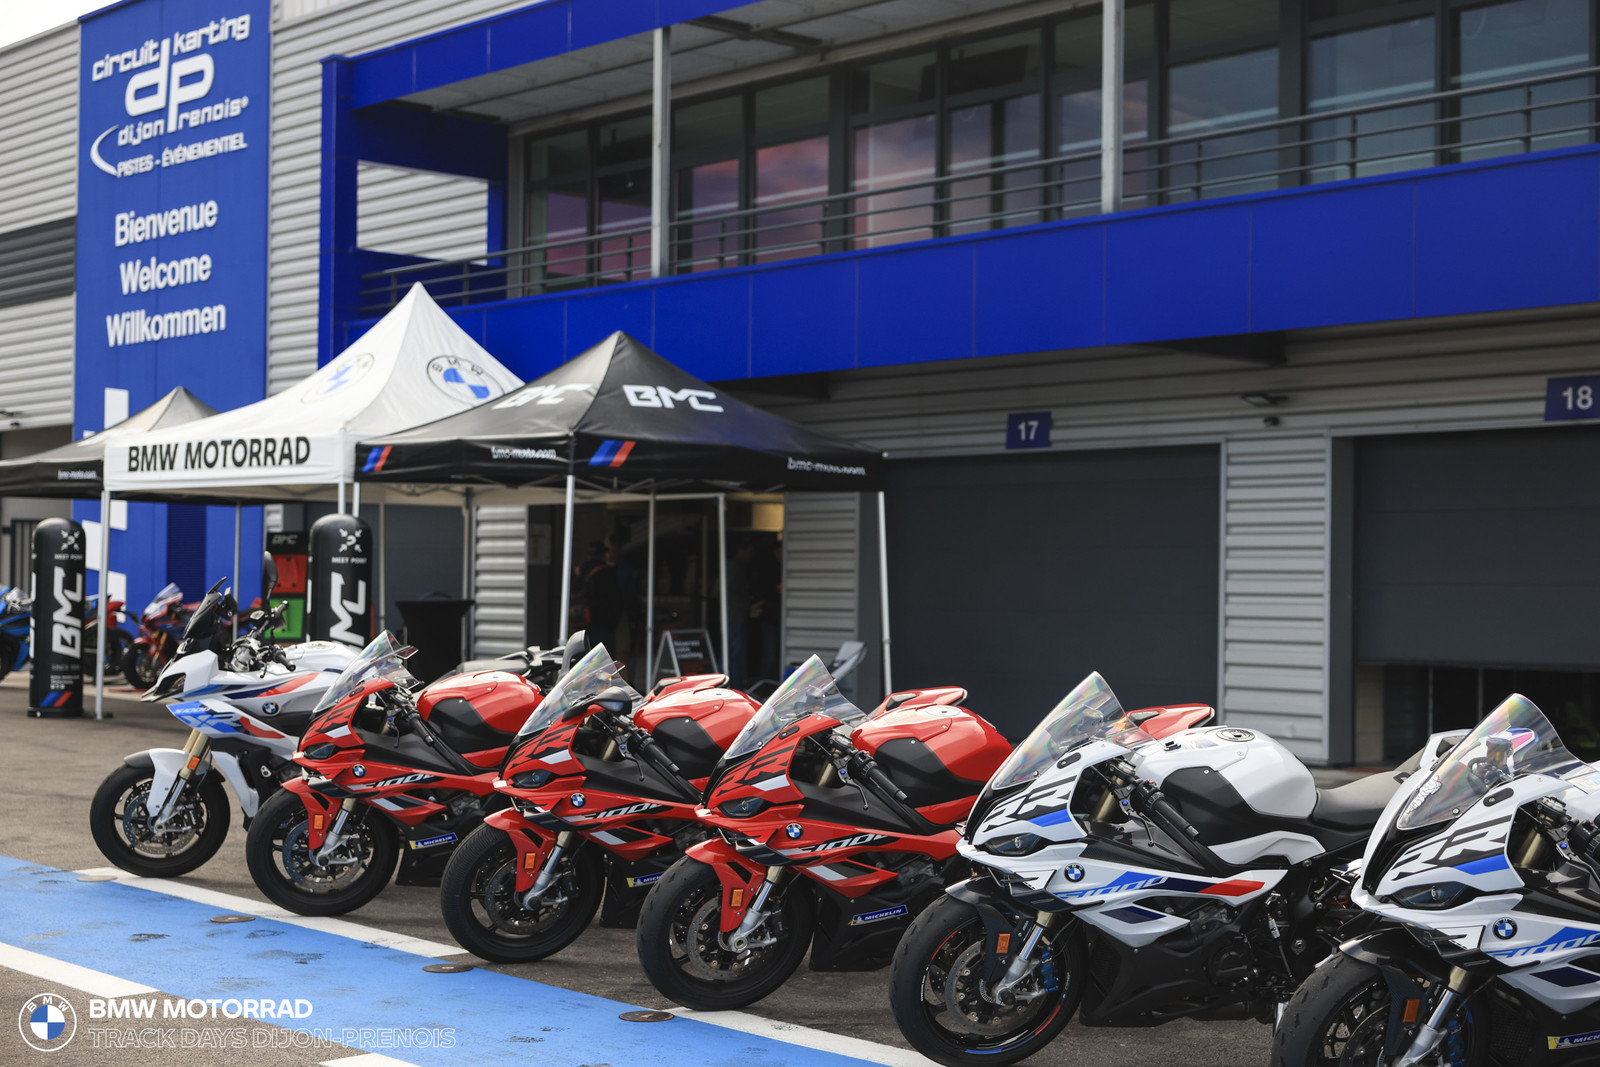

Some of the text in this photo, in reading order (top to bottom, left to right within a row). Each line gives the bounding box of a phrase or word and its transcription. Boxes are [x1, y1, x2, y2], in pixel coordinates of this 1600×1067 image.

[92, 14, 250, 82] circuit karting
[117, 118, 165, 147] dijon
[116, 153, 155, 178] PISTES
[115, 200, 218, 247] Bienvenue
[120, 254, 212, 295] Welcome
[106, 304, 226, 348] Willkommen
[622, 384, 724, 413] BMC
[1562, 385, 1593, 410] 18
[1017, 420, 1039, 440] 17
[128, 436, 311, 472] BMW MOTORRAD
[52, 565, 83, 659] BMC
[423, 836, 453, 845] MICHELIN
[864, 909, 902, 920] MICHELIN
